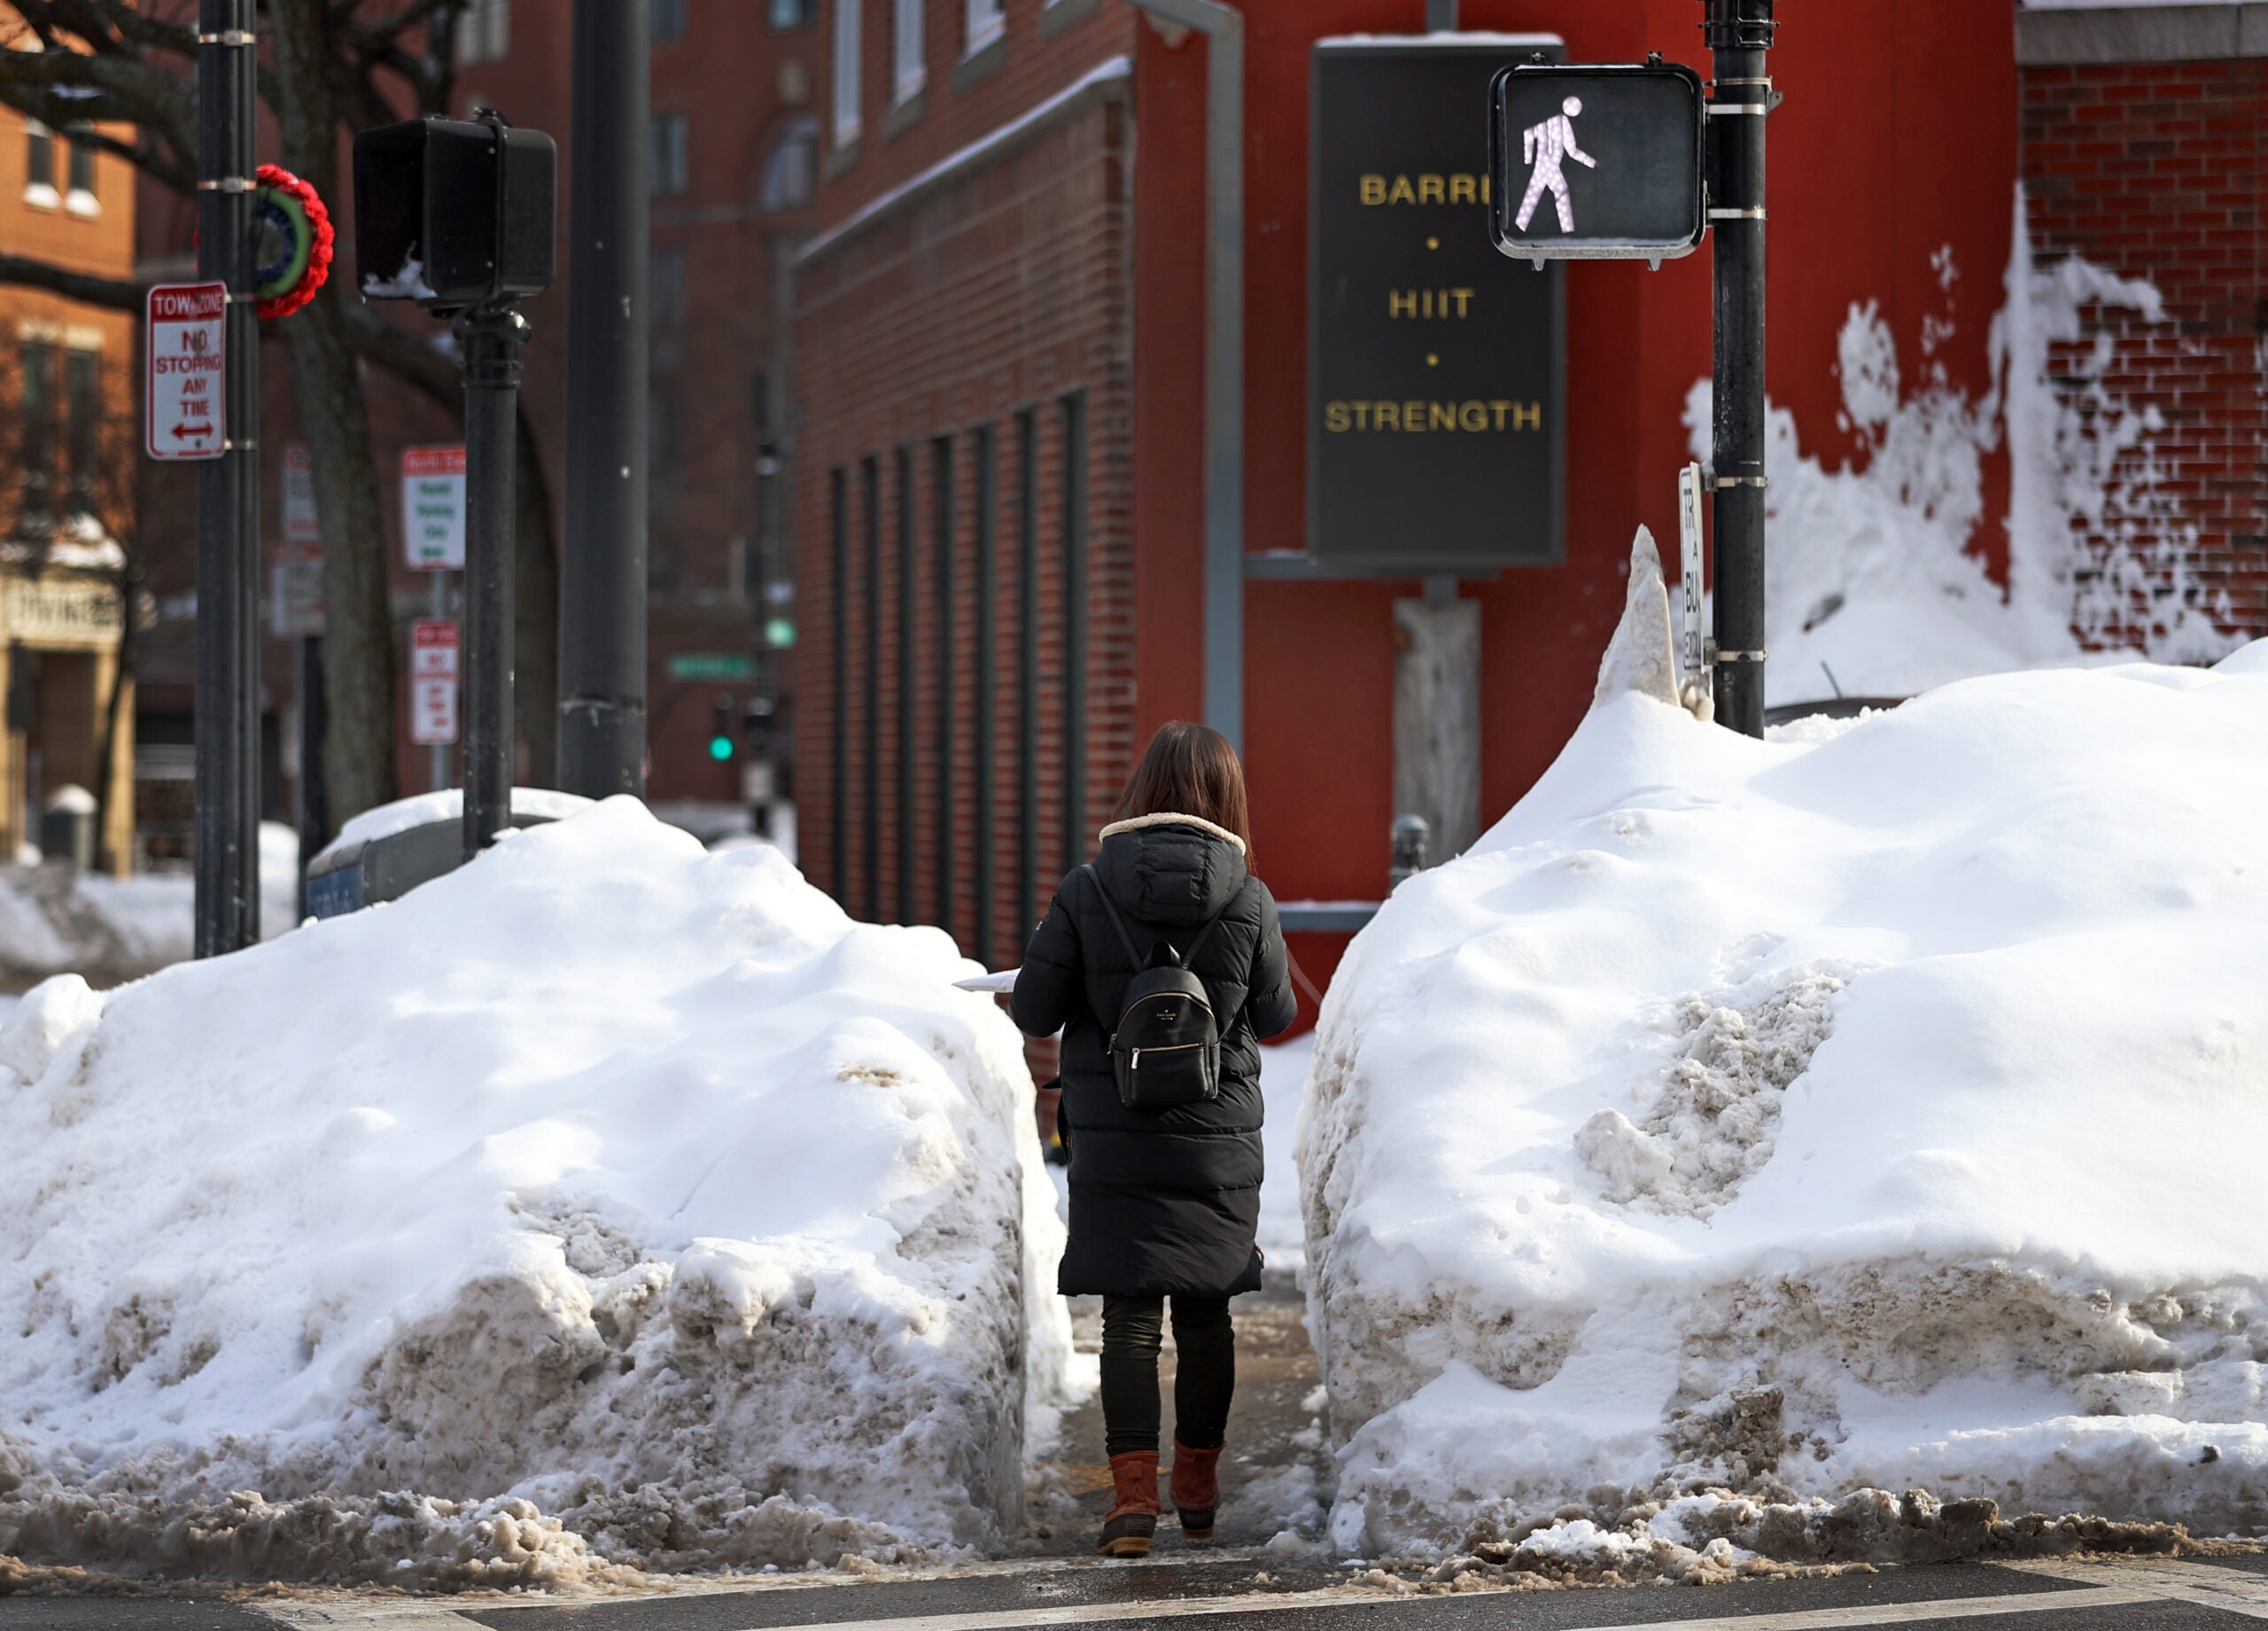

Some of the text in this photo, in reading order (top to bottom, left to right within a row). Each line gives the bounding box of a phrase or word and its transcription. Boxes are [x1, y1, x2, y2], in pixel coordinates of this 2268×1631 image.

[153, 291, 222, 316] TOW ZONE
[1388, 287, 1476, 320] HIIT
[182, 329, 208, 353] NO
[155, 355, 221, 375] STOPPING
[182, 377, 208, 396] ANY
[180, 400, 210, 418] TIME
[1324, 400, 1542, 432] STRENGTH
[1684, 489, 1694, 529] TR
